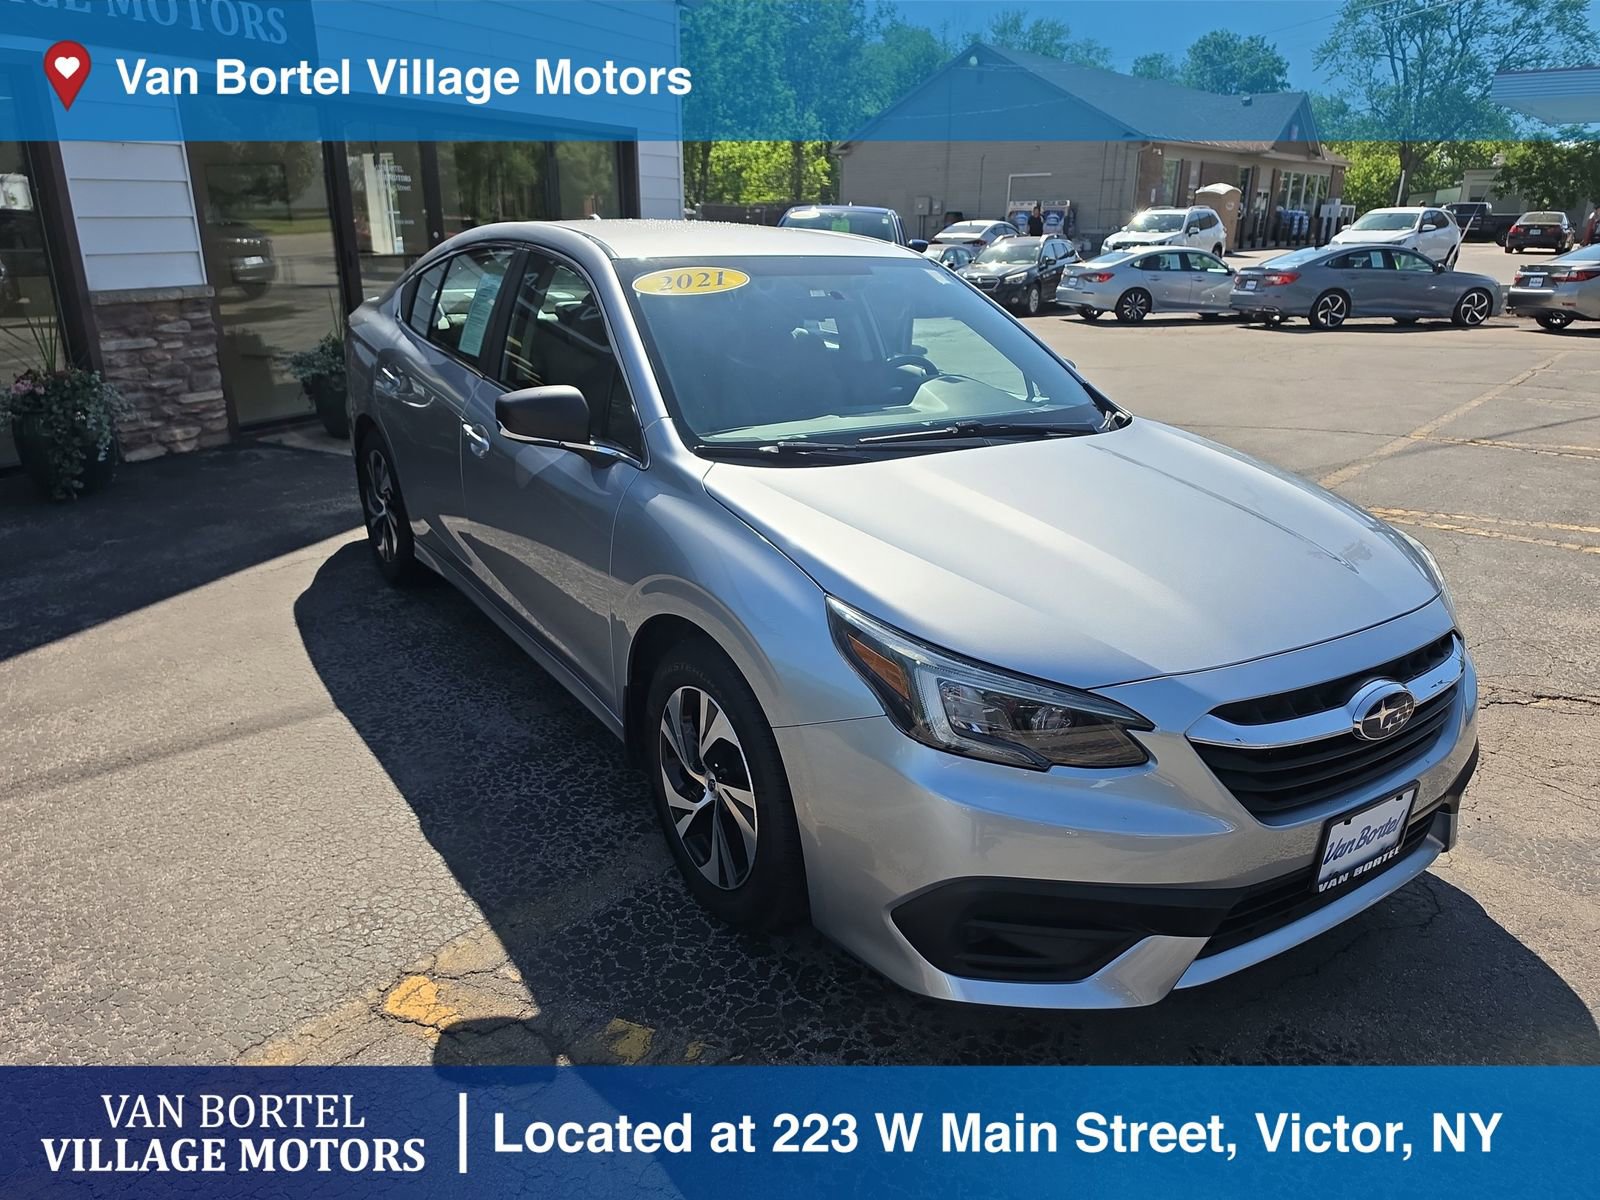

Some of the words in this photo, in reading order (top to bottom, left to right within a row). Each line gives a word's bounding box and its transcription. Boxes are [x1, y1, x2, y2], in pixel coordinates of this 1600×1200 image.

[659, 271, 726, 291] 2021
[1322, 838, 1356, 865] Van
[1354, 809, 1405, 850] Bortel
[1318, 872, 1349, 893] VAN
